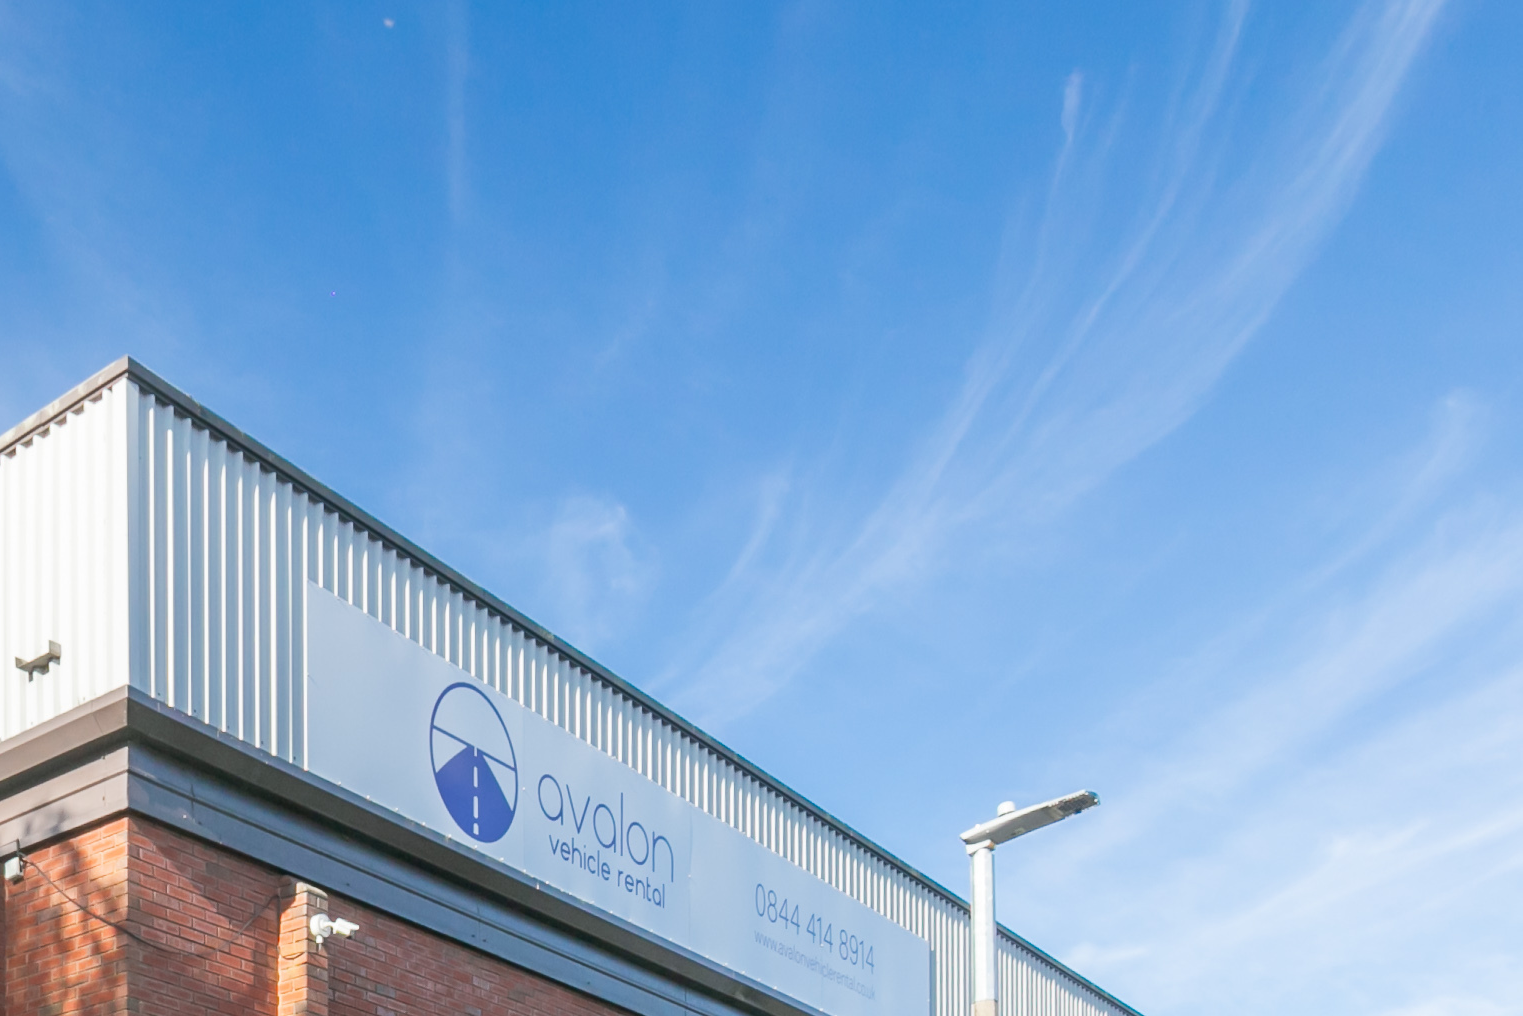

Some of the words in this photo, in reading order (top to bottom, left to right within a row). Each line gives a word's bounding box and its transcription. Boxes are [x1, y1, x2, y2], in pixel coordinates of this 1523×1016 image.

[538, 774, 674, 883] avalon
[548, 834, 611, 881] vehicle
[618, 869, 665, 909] rental
[755, 883, 800, 936] 0844
[806, 913, 834, 954] 414
[839, 928, 875, 975] 8914
